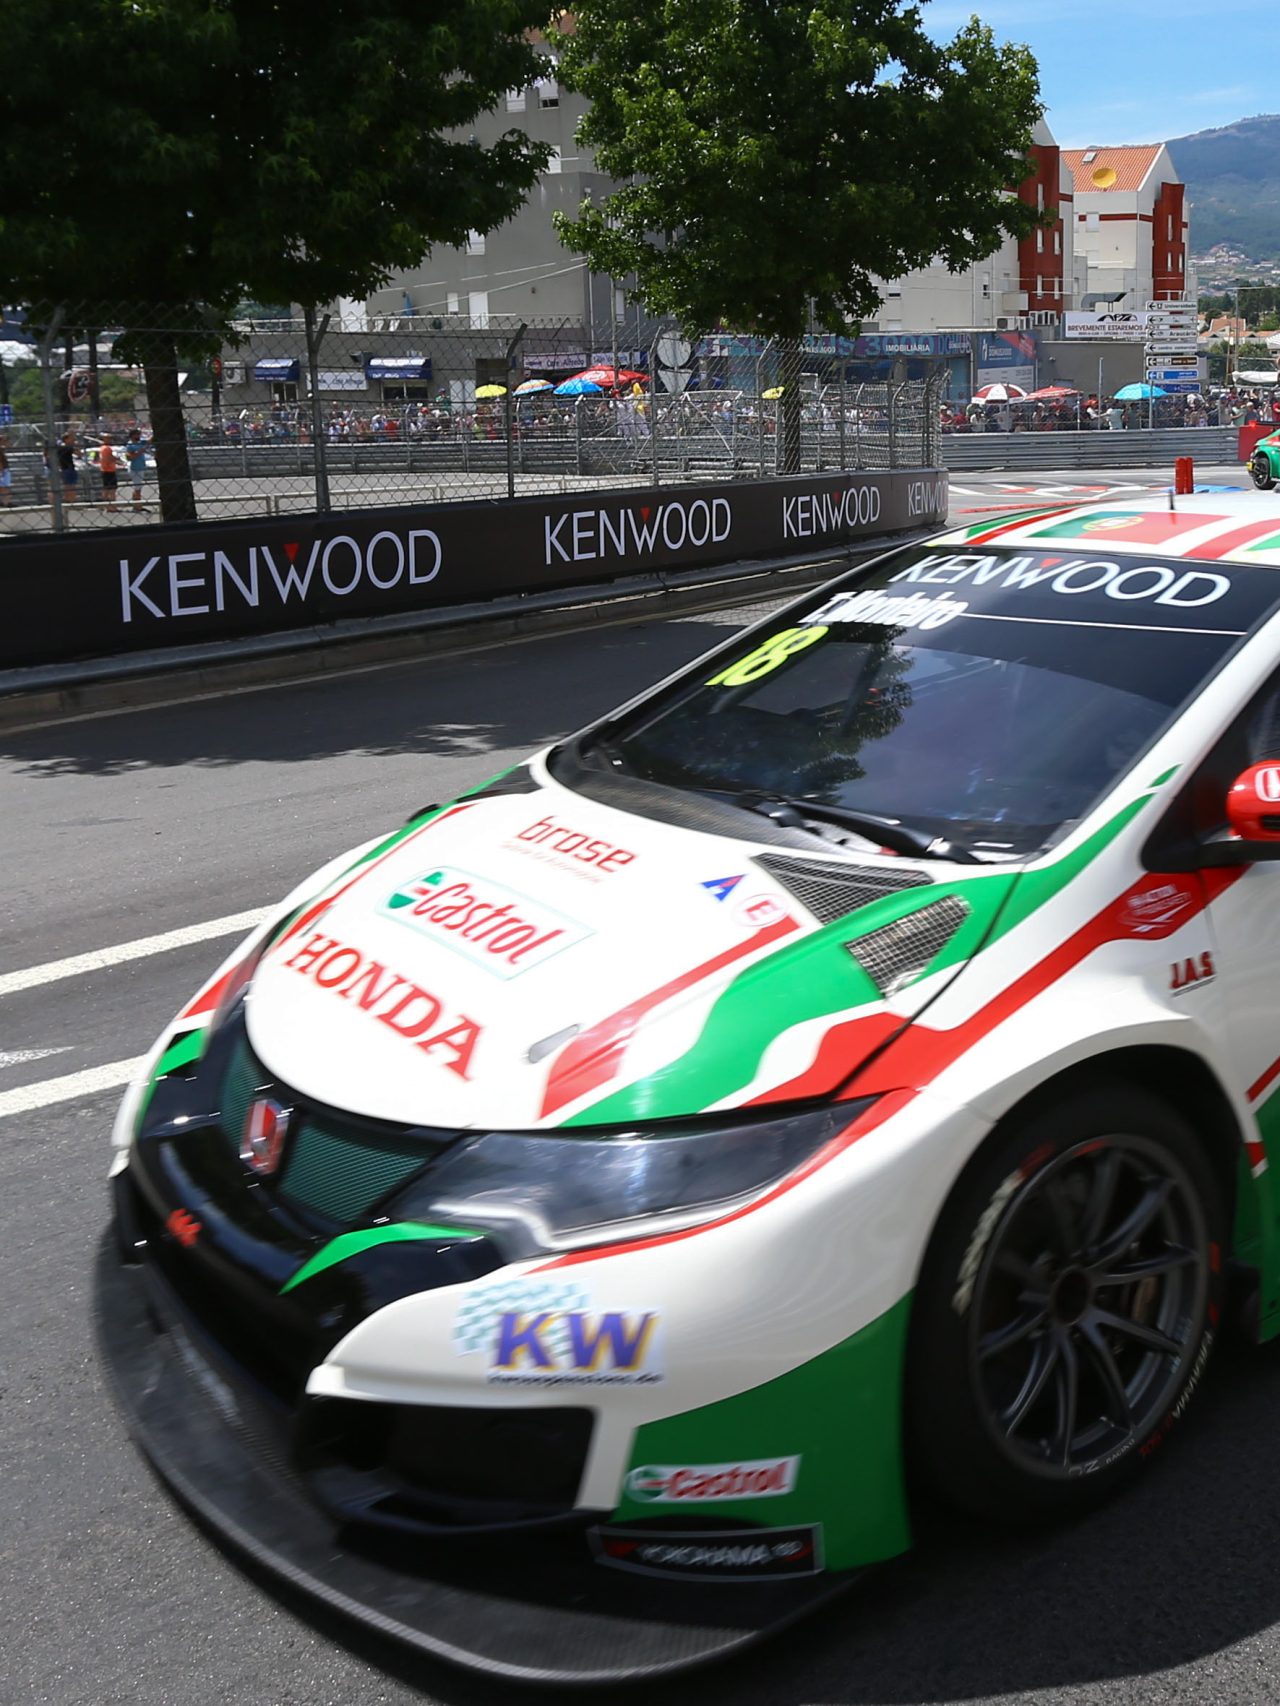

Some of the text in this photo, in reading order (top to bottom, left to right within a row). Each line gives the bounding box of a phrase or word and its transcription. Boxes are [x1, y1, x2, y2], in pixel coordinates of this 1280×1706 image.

[885, 344, 931, 353] IMOBILIÁRIA
[544, 498, 732, 565] KENWOOD
[783, 485, 881, 538] KENWOOD
[119, 528, 442, 623] KENWOOD
[888, 554, 1230, 607] KENWOOD
[705, 625, 829, 687] 18
[513, 815, 639, 873] brose
[410, 882, 564, 966] Castrol
[283, 933, 487, 1083] HONDA
[491, 1310, 659, 1372] KW
[666, 1459, 789, 1500] Castrol
